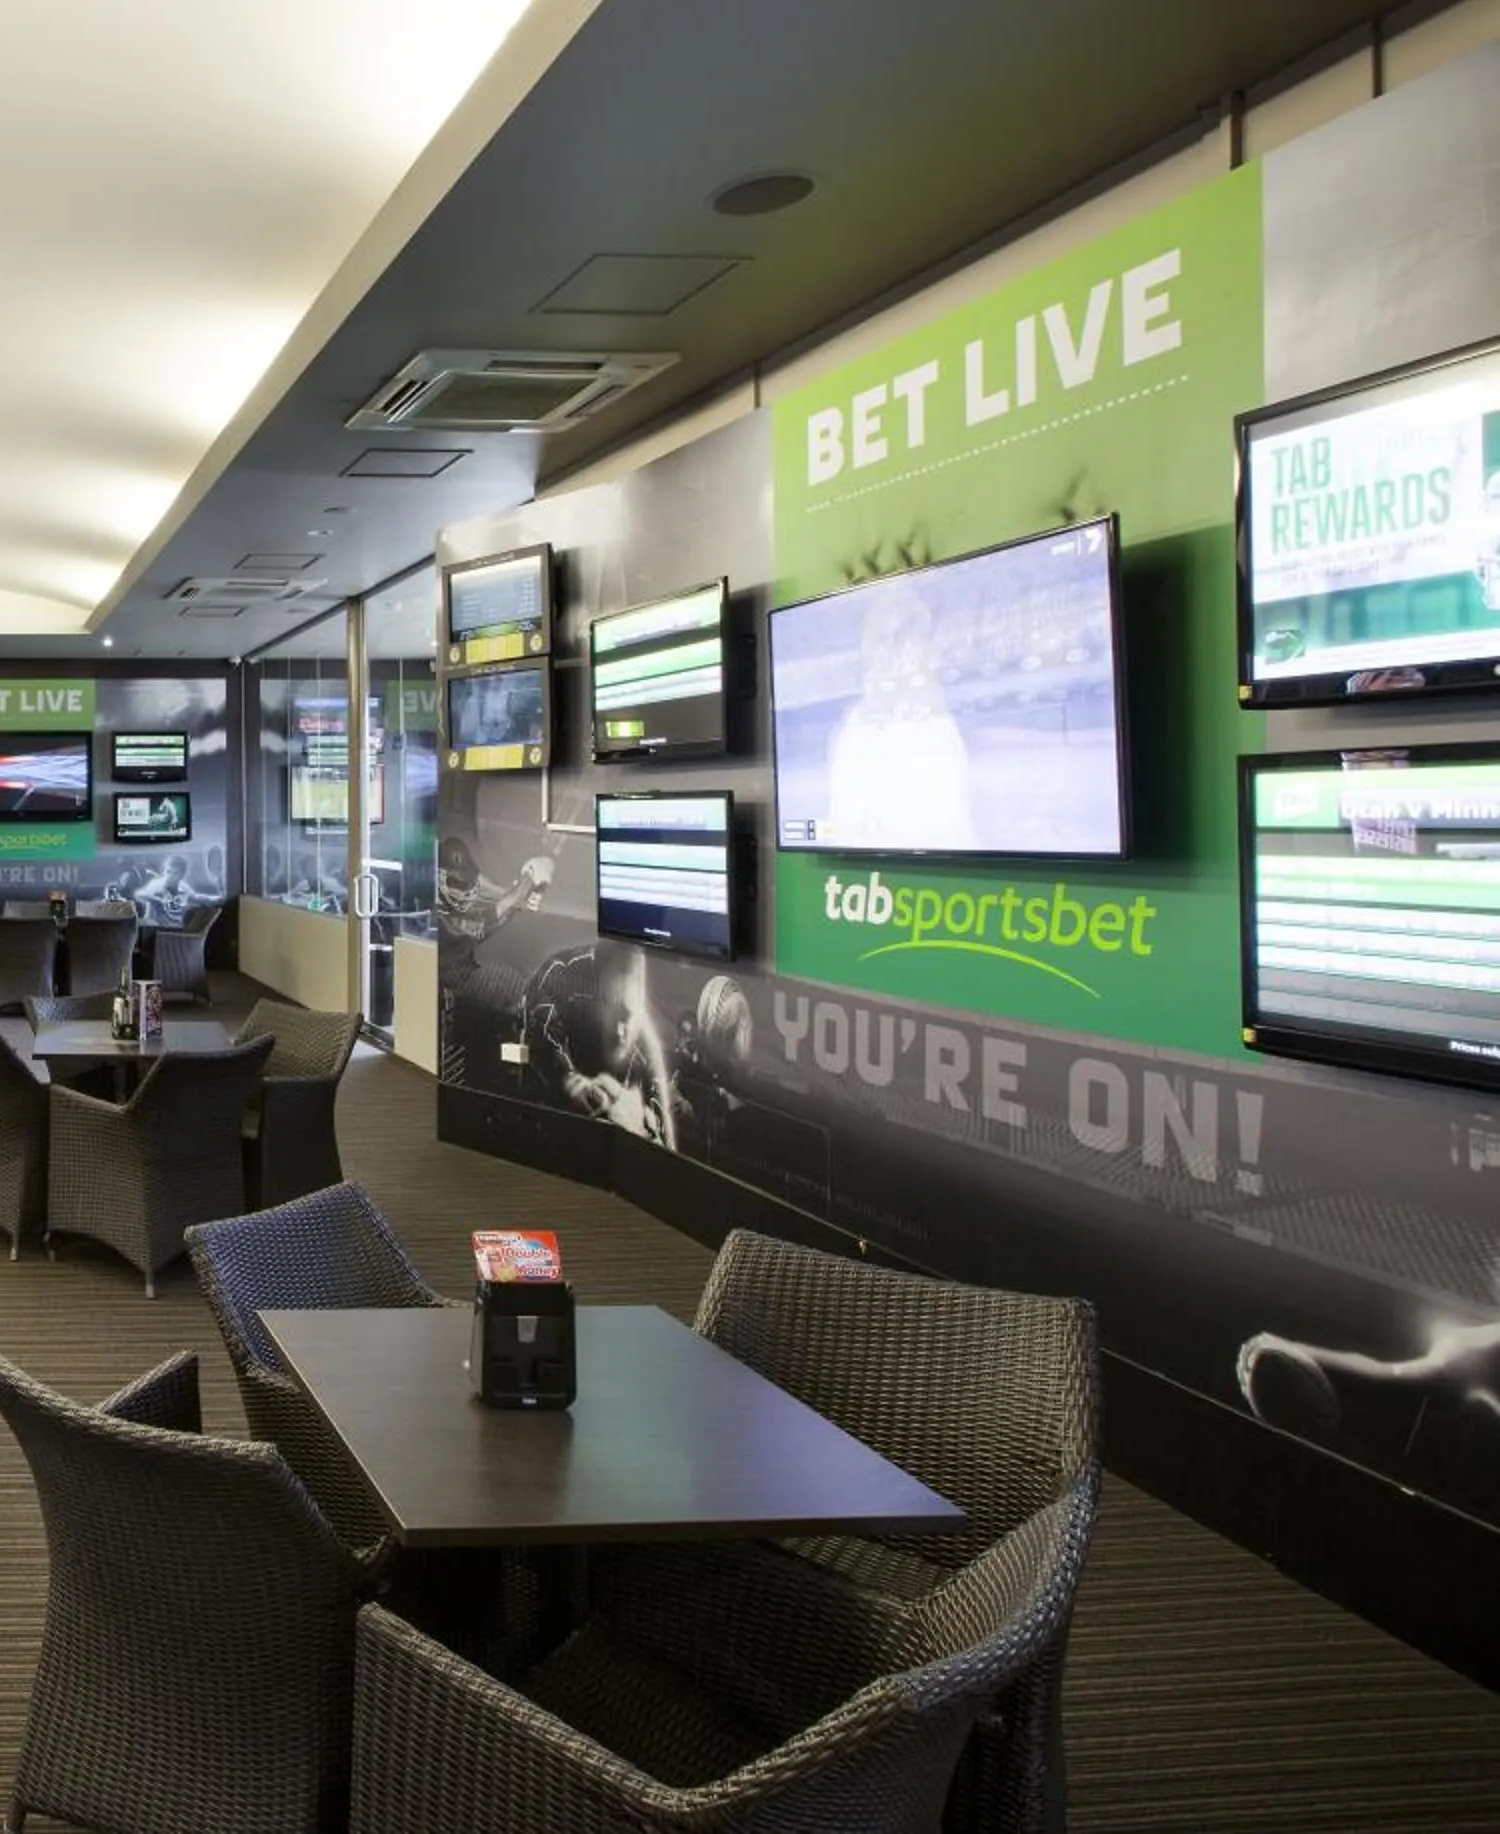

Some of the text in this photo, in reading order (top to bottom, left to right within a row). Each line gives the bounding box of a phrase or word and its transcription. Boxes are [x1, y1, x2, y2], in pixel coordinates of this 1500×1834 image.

[807, 247, 1183, 487] BET LIVE
[1270, 436, 1332, 499] TAB
[1271, 466, 1452, 556] REWARDS
[20, 690, 83, 712] LIVE
[43, 864, 79, 883] ON!
[824, 871, 1157, 956] tabsportsbet
[773, 991, 1264, 1197] YOU'RE ON!
